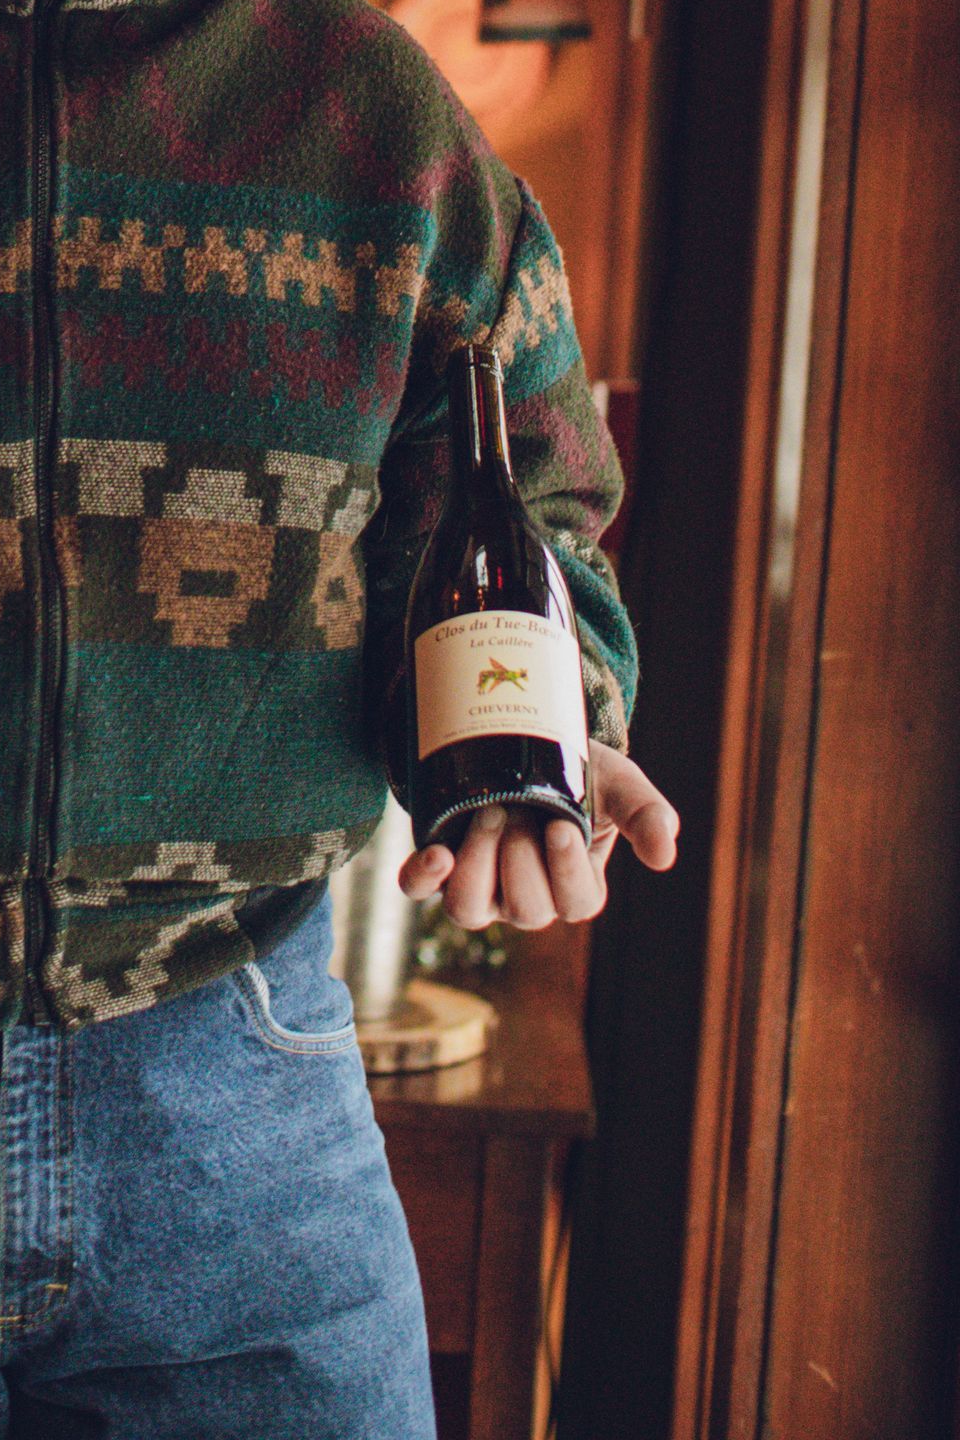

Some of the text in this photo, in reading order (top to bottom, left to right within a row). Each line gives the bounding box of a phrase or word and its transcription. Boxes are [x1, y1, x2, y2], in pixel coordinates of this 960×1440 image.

[434, 624, 465, 642] Clos
[469, 618, 488, 631] du
[470, 639, 484, 648] La
[468, 703, 539, 716] CHEVERNY
